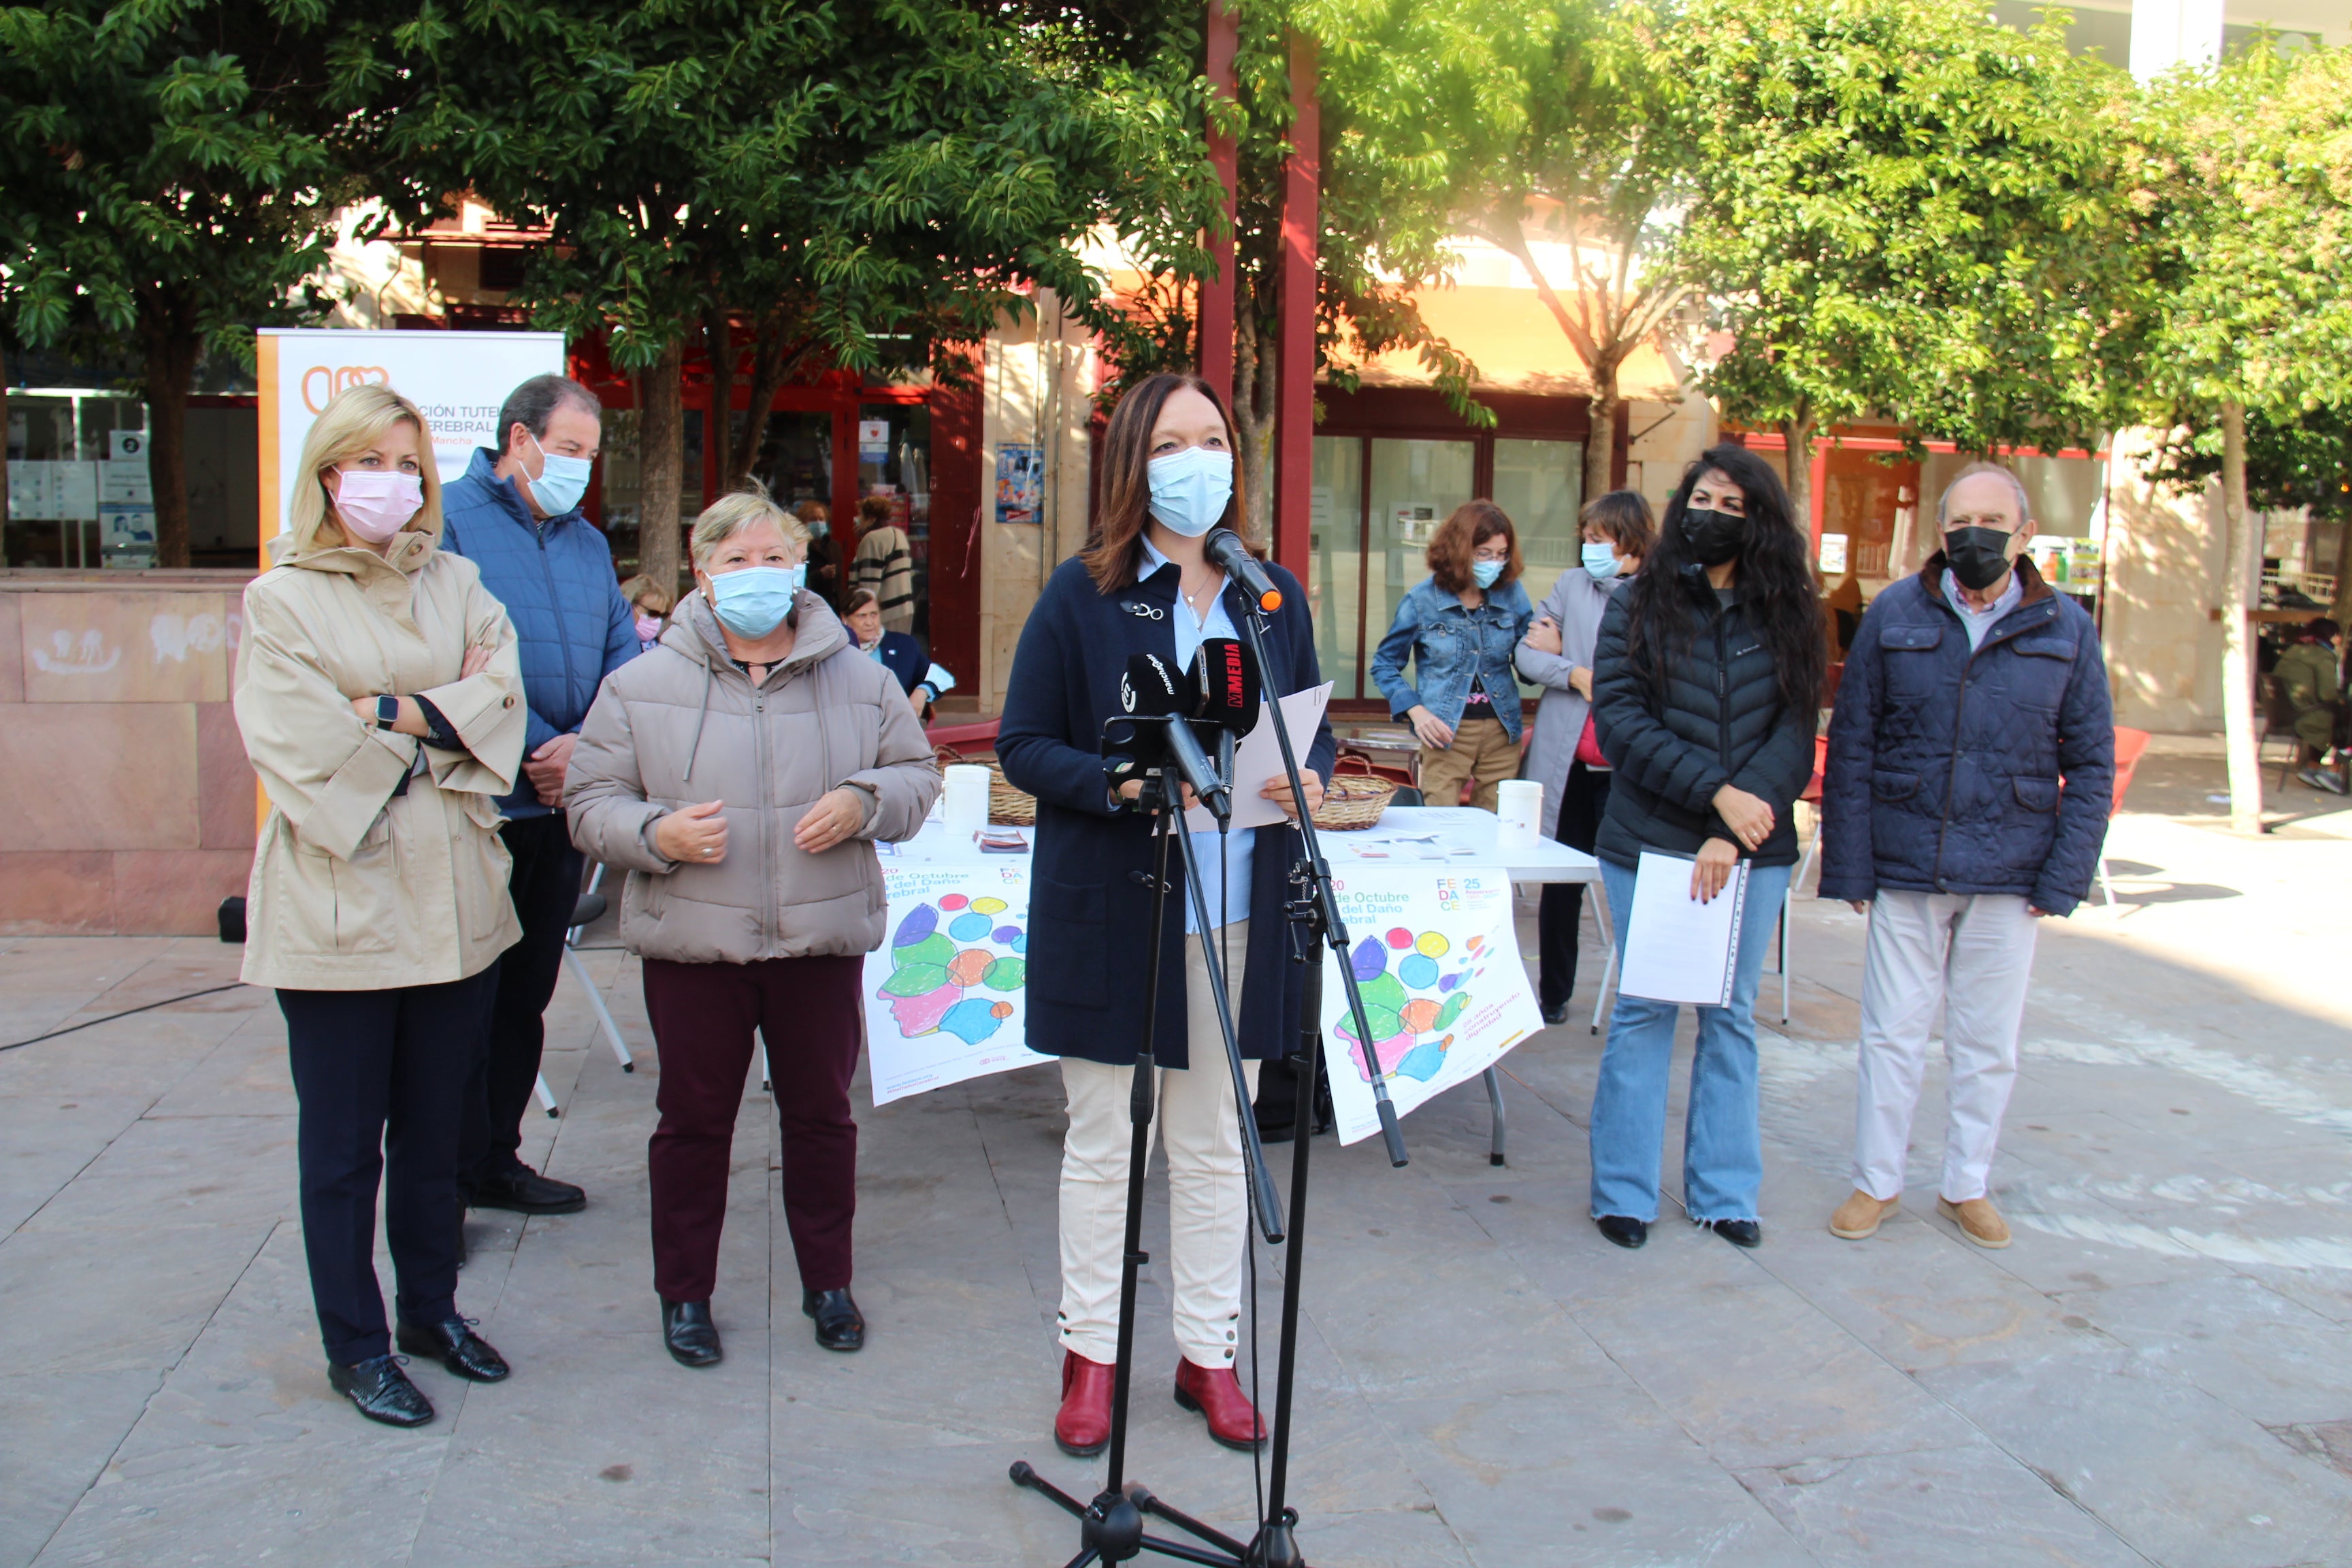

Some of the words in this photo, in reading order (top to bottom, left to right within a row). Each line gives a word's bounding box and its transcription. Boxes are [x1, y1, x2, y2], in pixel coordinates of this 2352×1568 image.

[431, 437, 472, 445] Mancha
[909, 872, 969, 880] Octubre
[894, 880, 916, 889] del
[921, 878, 960, 886] Daño
[1330, 879, 1345, 891] 20
[1437, 879, 1456, 889] FE
[1464, 878, 1481, 889] 25
[886, 886, 930, 900] rebral
[1334, 892, 1350, 902] de
[1355, 892, 1409, 902] Octubre
[1439, 890, 1460, 900] DA
[1341, 904, 1362, 914] del
[1367, 904, 1403, 913] Daño
[1441, 900, 1461, 911] CE
[1464, 992, 1521, 1035] construyendo
[1465, 1012, 1502, 1041] dignidad
